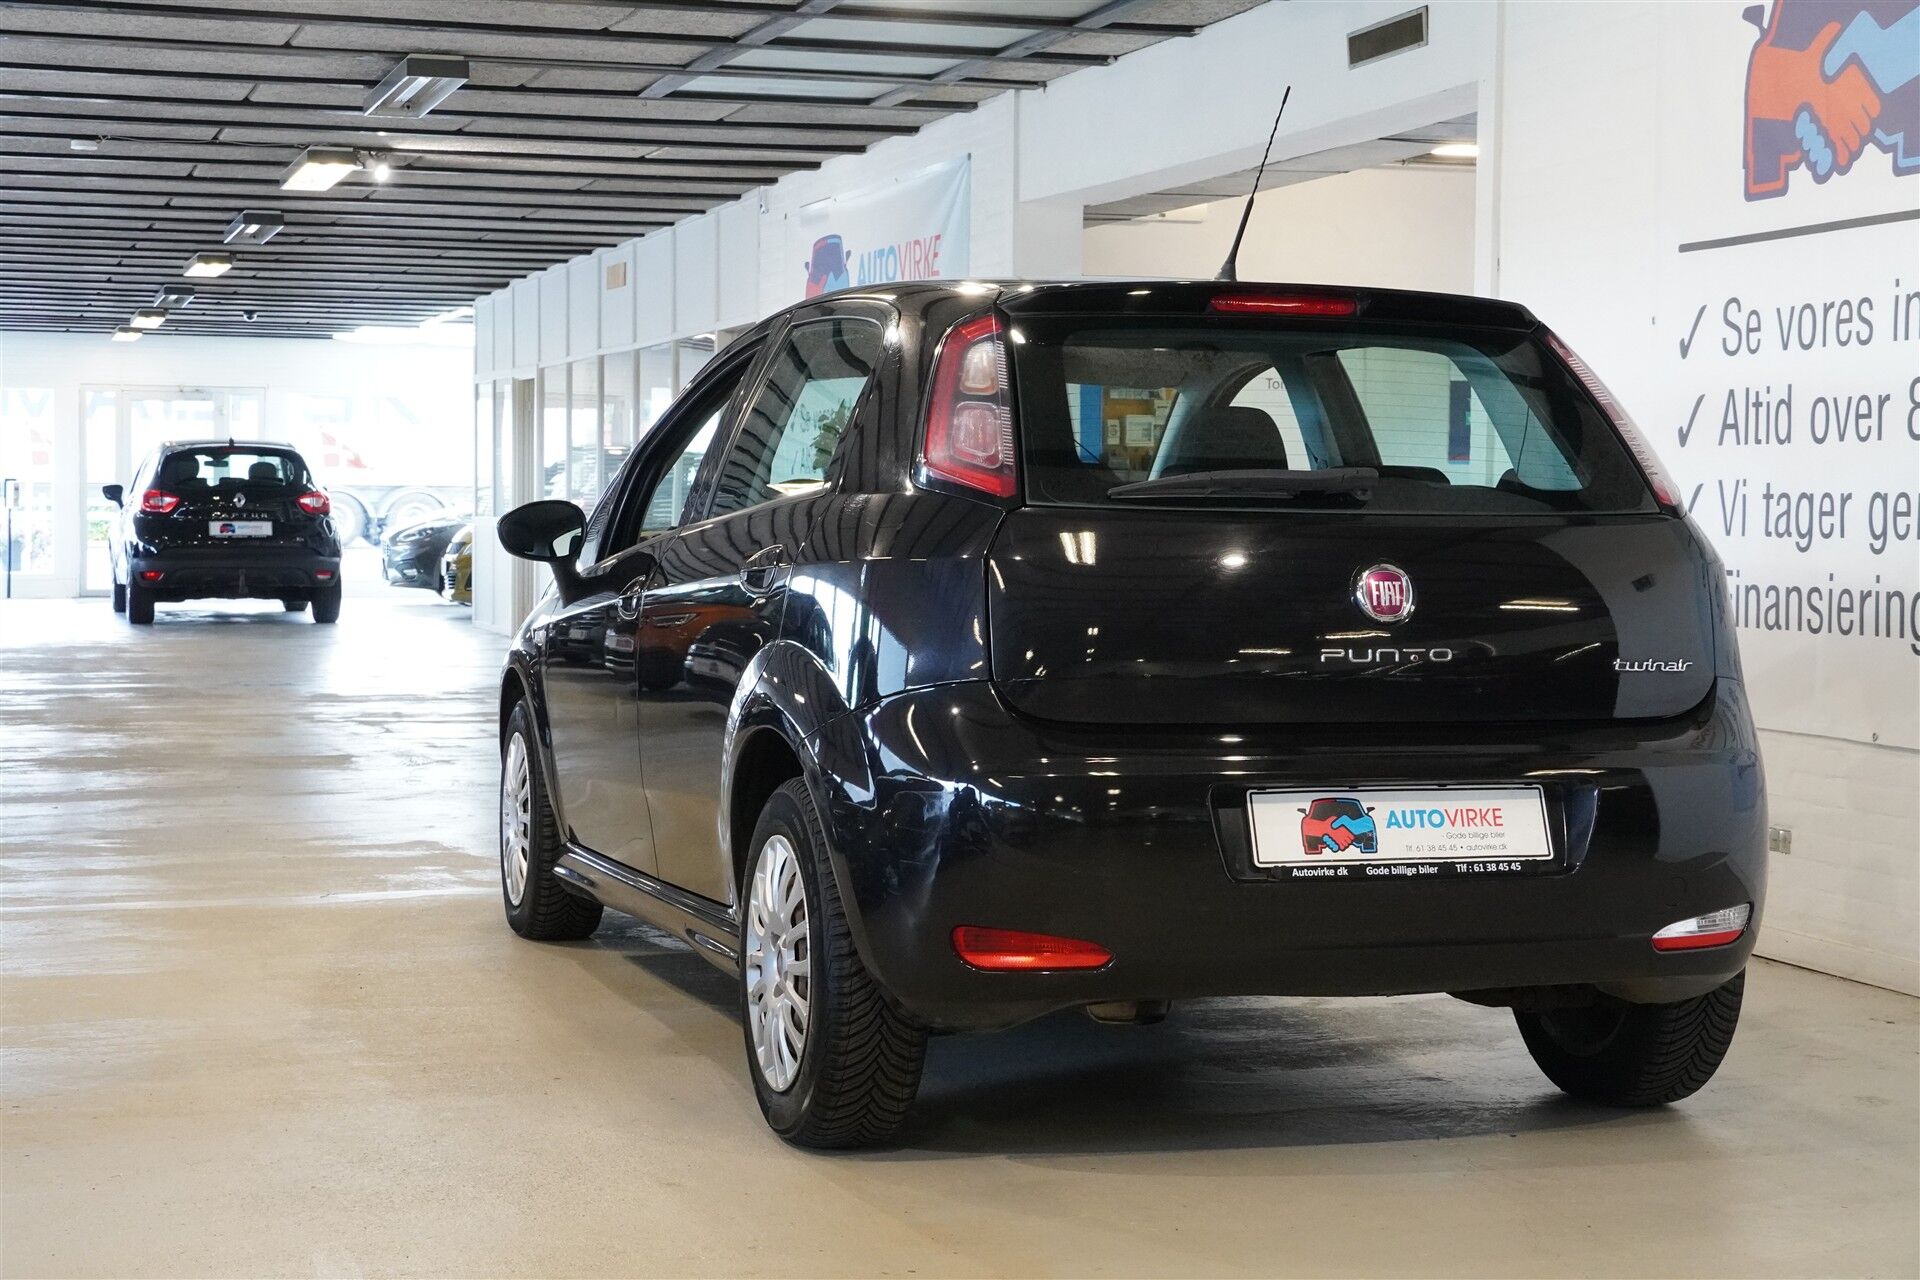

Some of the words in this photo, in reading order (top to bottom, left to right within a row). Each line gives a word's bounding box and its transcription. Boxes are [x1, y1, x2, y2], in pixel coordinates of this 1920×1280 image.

[857, 234, 941, 286] AUTOVIRKE
[1722, 297, 1762, 357] Se
[1776, 297, 1874, 350] vores
[1719, 384, 1792, 446] Altid
[1810, 394, 1891, 445] over
[1718, 479, 1747, 537] Vi
[1762, 482, 1853, 553] tager
[1371, 580, 1402, 606] FIAT
[1320, 648, 1453, 663] PUNTO
[1612, 658, 1693, 672] twinair
[1386, 808, 1504, 829] AUTOVIRKE
[1445, 832, 1467, 840] Gode
[1468, 831, 1489, 841] billige
[1490, 831, 1506, 839] biler
[1427, 844, 1436, 852] 38
[1438, 844, 1447, 852] 45
[1449, 844, 1458, 852] 45
[1292, 867, 1335, 877] Autovirke
[1337, 866, 1349, 876] dk
[1366, 866, 1390, 876] Gode
[1391, 865, 1418, 877] billige
[1418, 864, 1439, 874] biler
[1473, 863, 1485, 872] 61
[1485, 862, 1497, 872] 38
[1498, 862, 1510, 871] 45
[1510, 862, 1522, 871] 45
